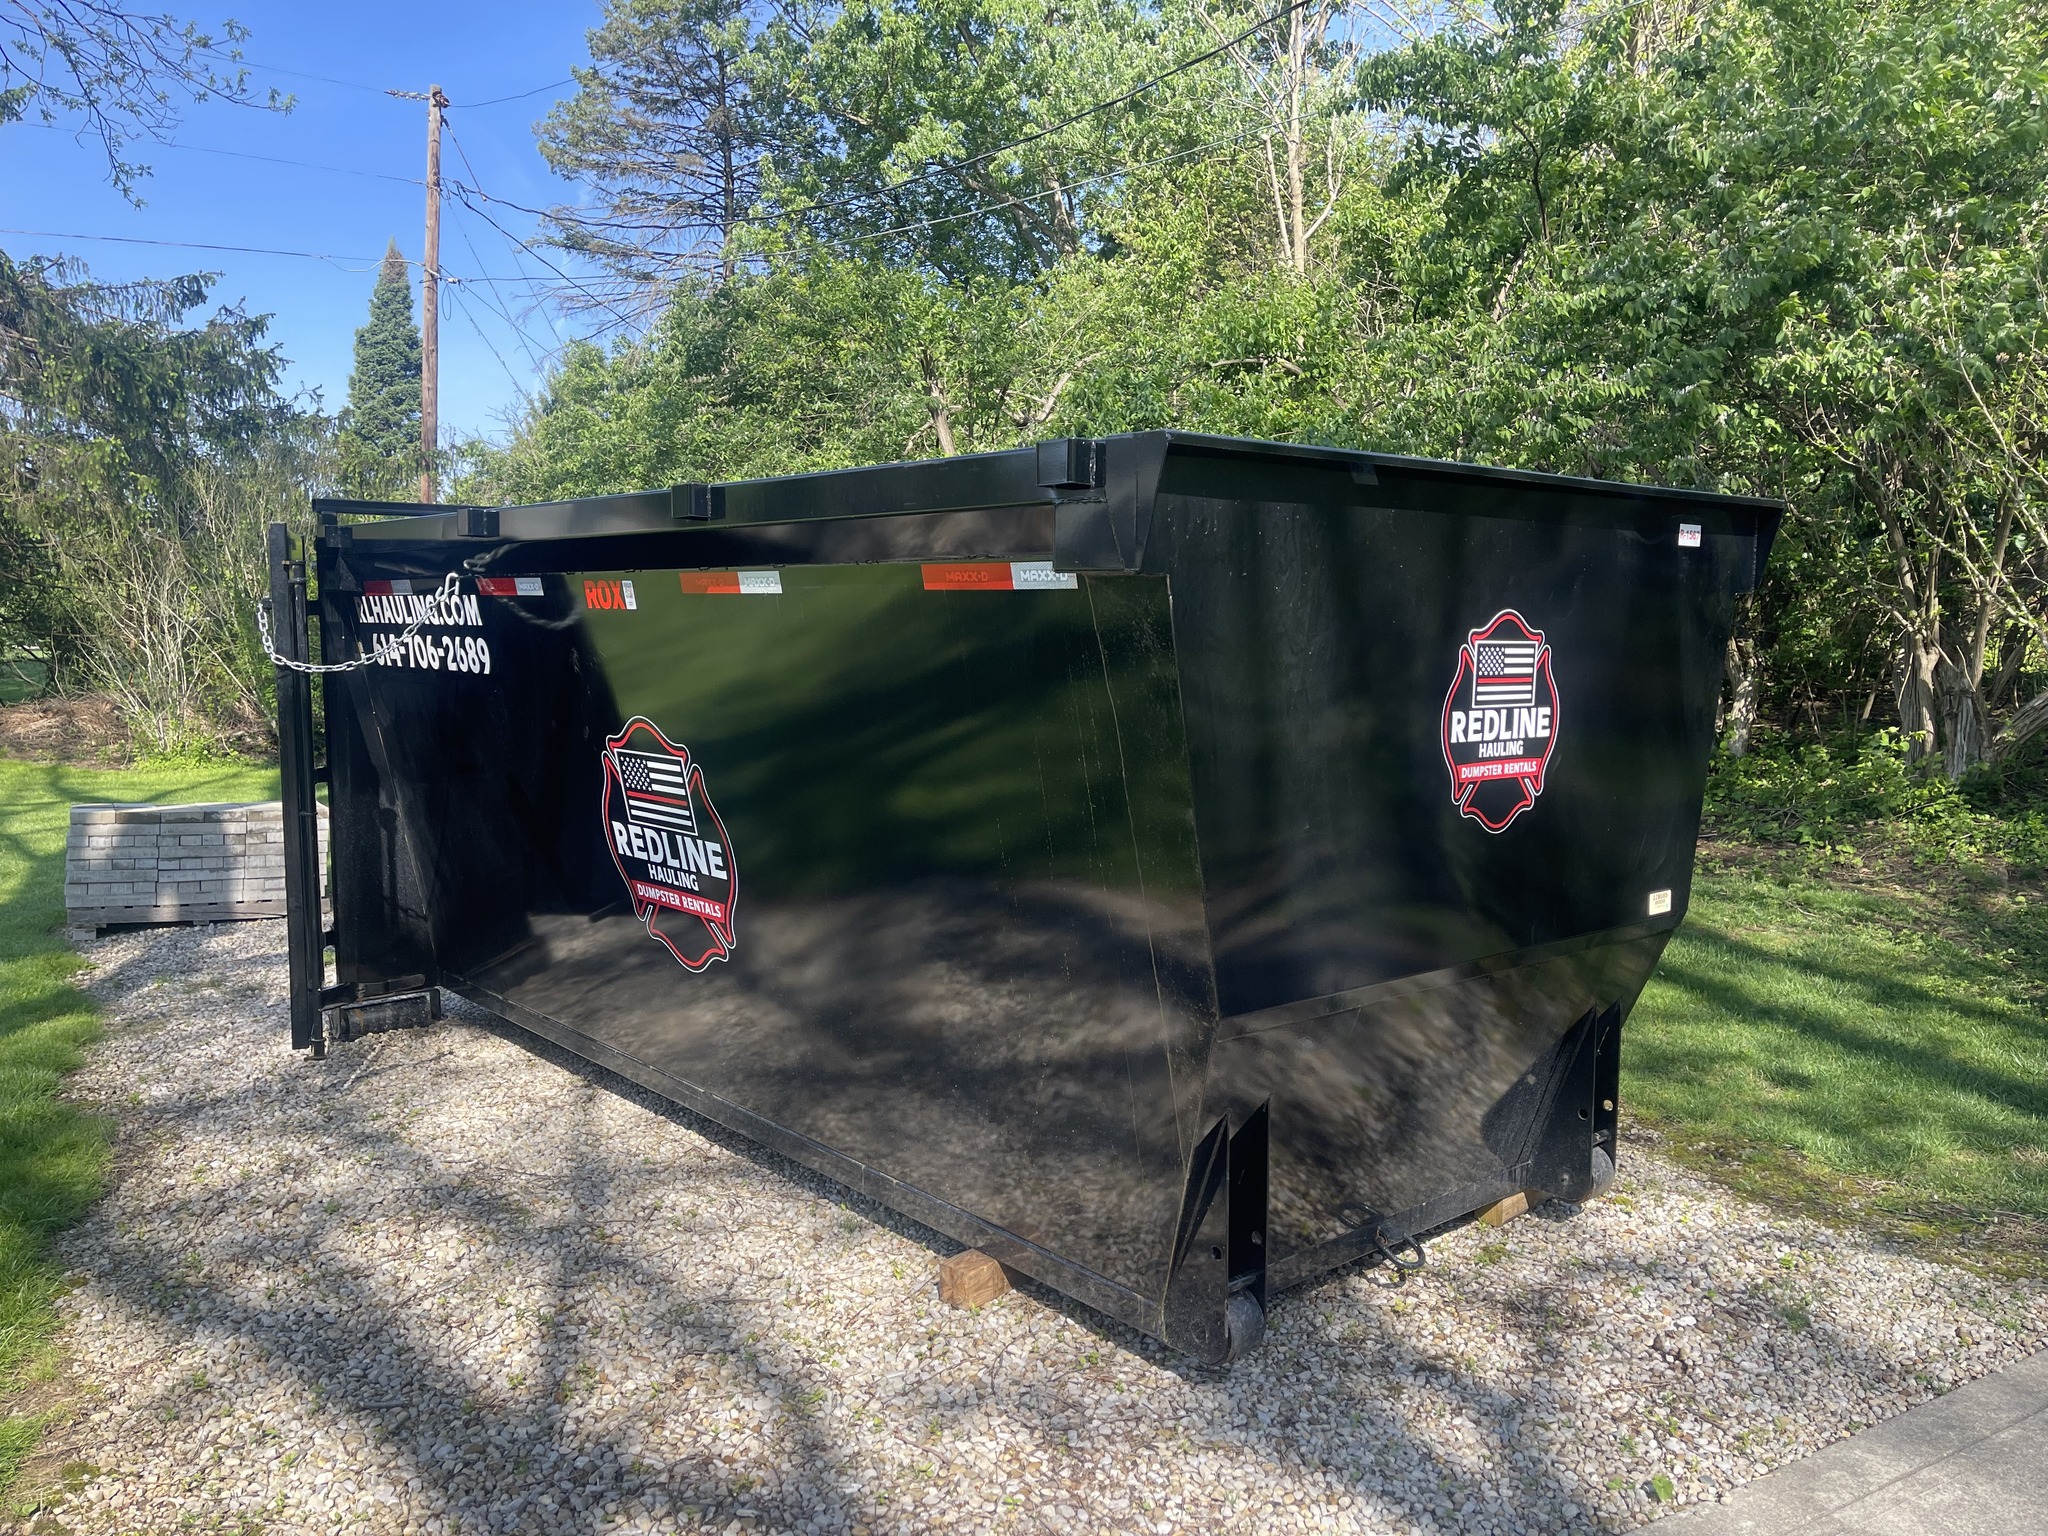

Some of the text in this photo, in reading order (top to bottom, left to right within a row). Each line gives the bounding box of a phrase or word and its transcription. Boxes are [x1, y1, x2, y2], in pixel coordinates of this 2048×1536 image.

[354, 594, 483, 626] RLHAULING.COM
[584, 580, 626, 610] ROX
[372, 633, 491, 675] 614-706-2689
[1450, 706, 1551, 743] REDLINE
[1478, 740, 1524, 758] HAULING
[1461, 761, 1537, 779] DUMPSTER RENTALS
[611, 820, 728, 880] REDLINE
[647, 863, 699, 891] HAULING
[636, 883, 722, 918] DUMPSTER RENTALS
